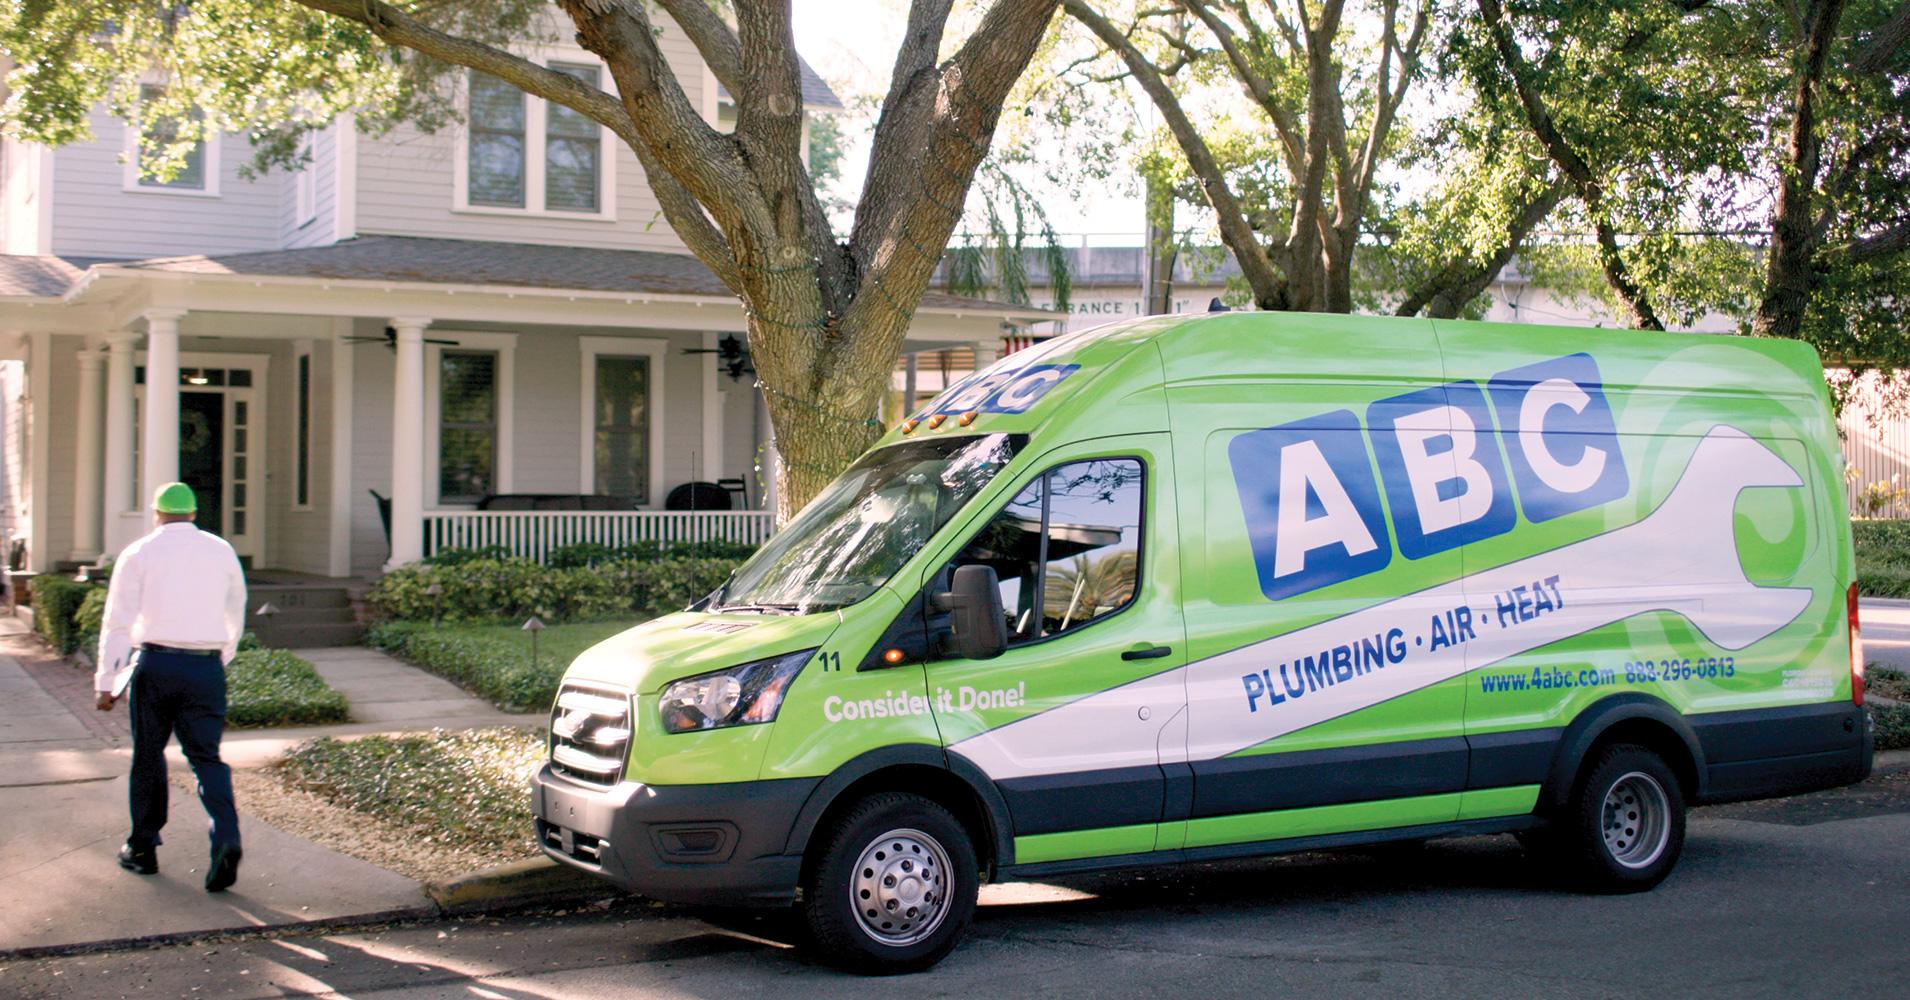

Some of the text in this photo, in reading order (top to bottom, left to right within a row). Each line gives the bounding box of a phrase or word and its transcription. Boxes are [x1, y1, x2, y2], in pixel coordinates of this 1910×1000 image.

[1273, 378, 1607, 578] ABC
[817, 650, 841, 672] 11
[1242, 574, 1564, 713] PLUMBING AIR HEAT
[1480, 656, 1736, 693] www.4abc.com 888-296-0813
[823, 680, 1026, 723] Consider it Done!
